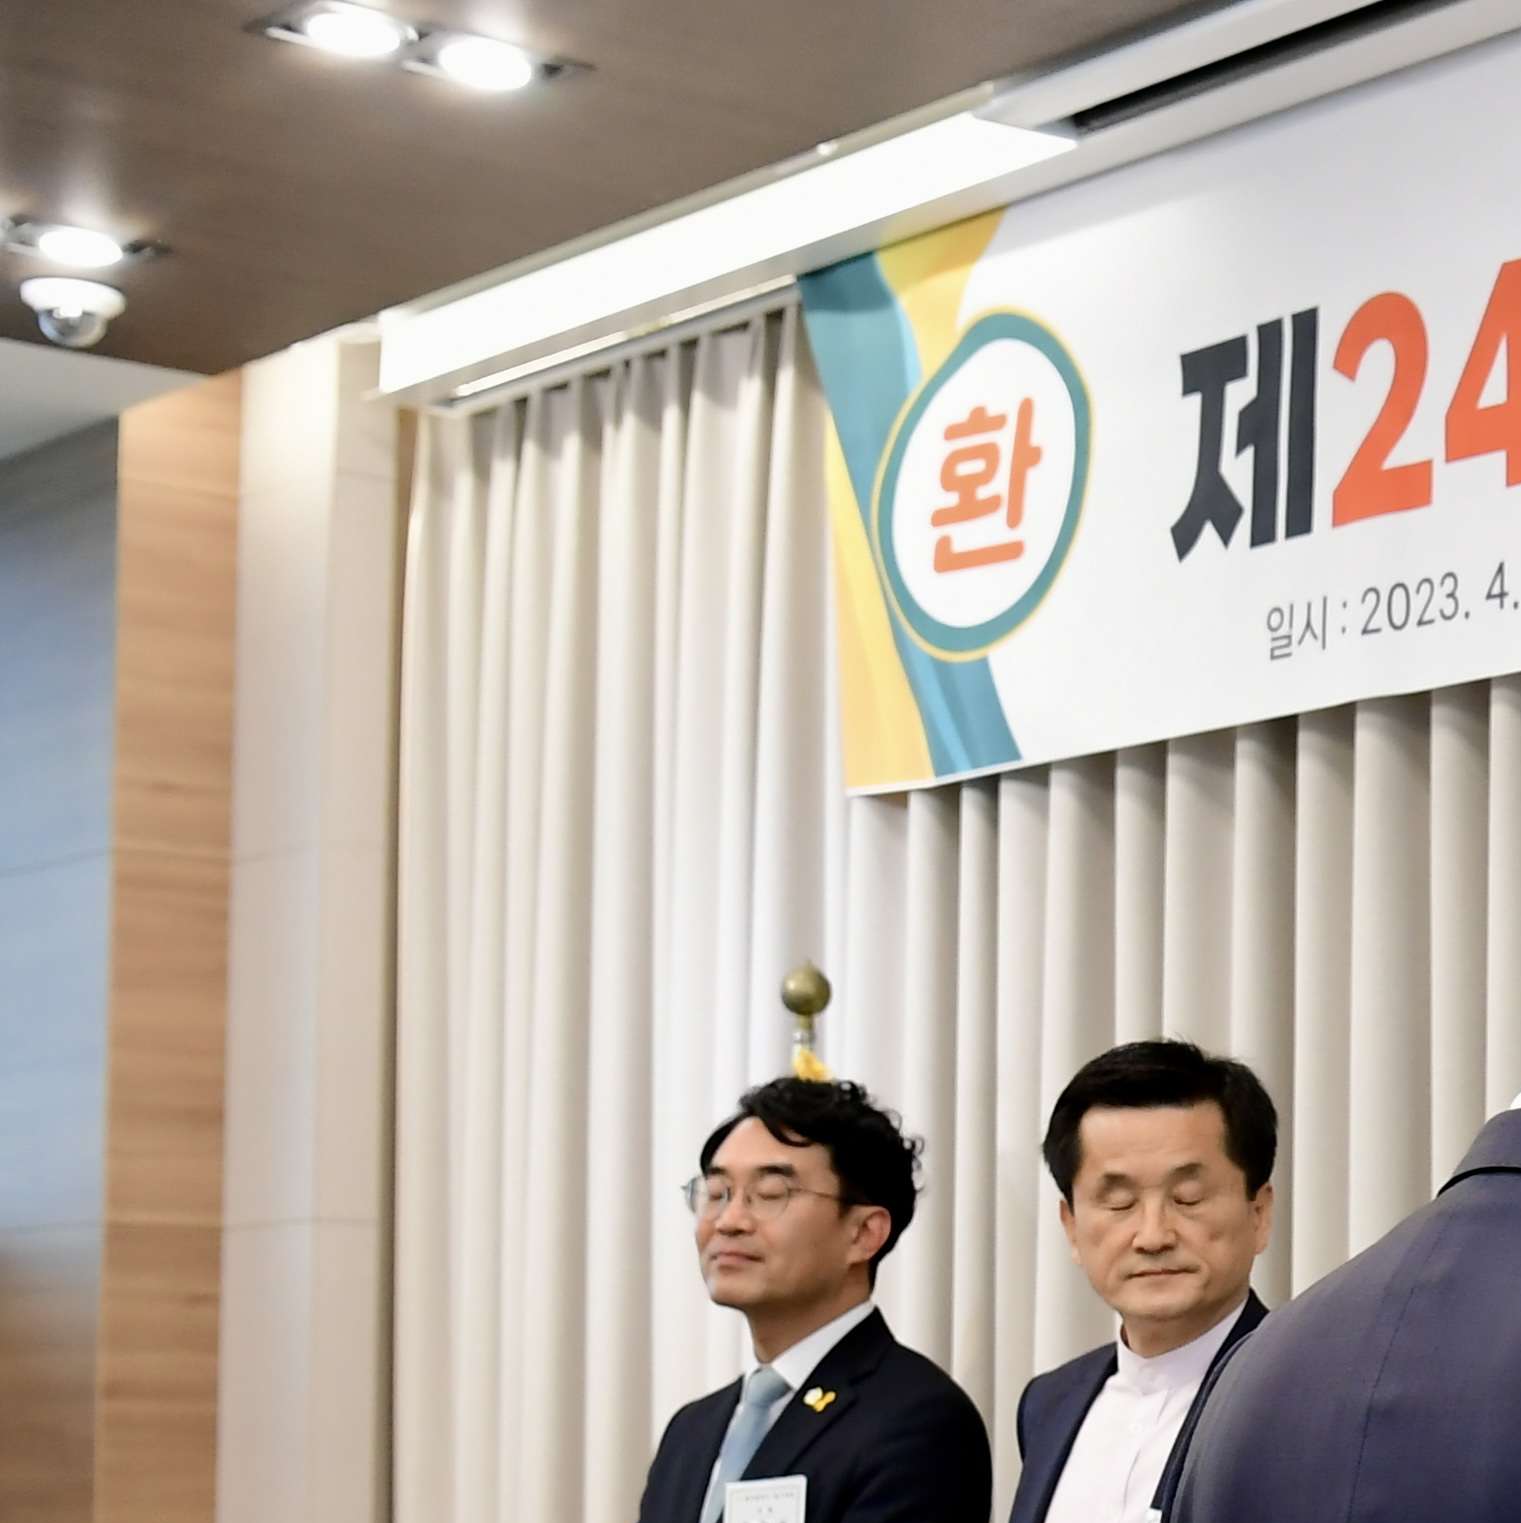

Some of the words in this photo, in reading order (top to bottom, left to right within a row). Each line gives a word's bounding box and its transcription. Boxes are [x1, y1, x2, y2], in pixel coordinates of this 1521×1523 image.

[931, 398, 1041, 573] 환
[1266, 596, 1328, 661] 일시
[1360, 571, 1471, 637] 2023.
[1485, 560, 1520, 611] 4.
